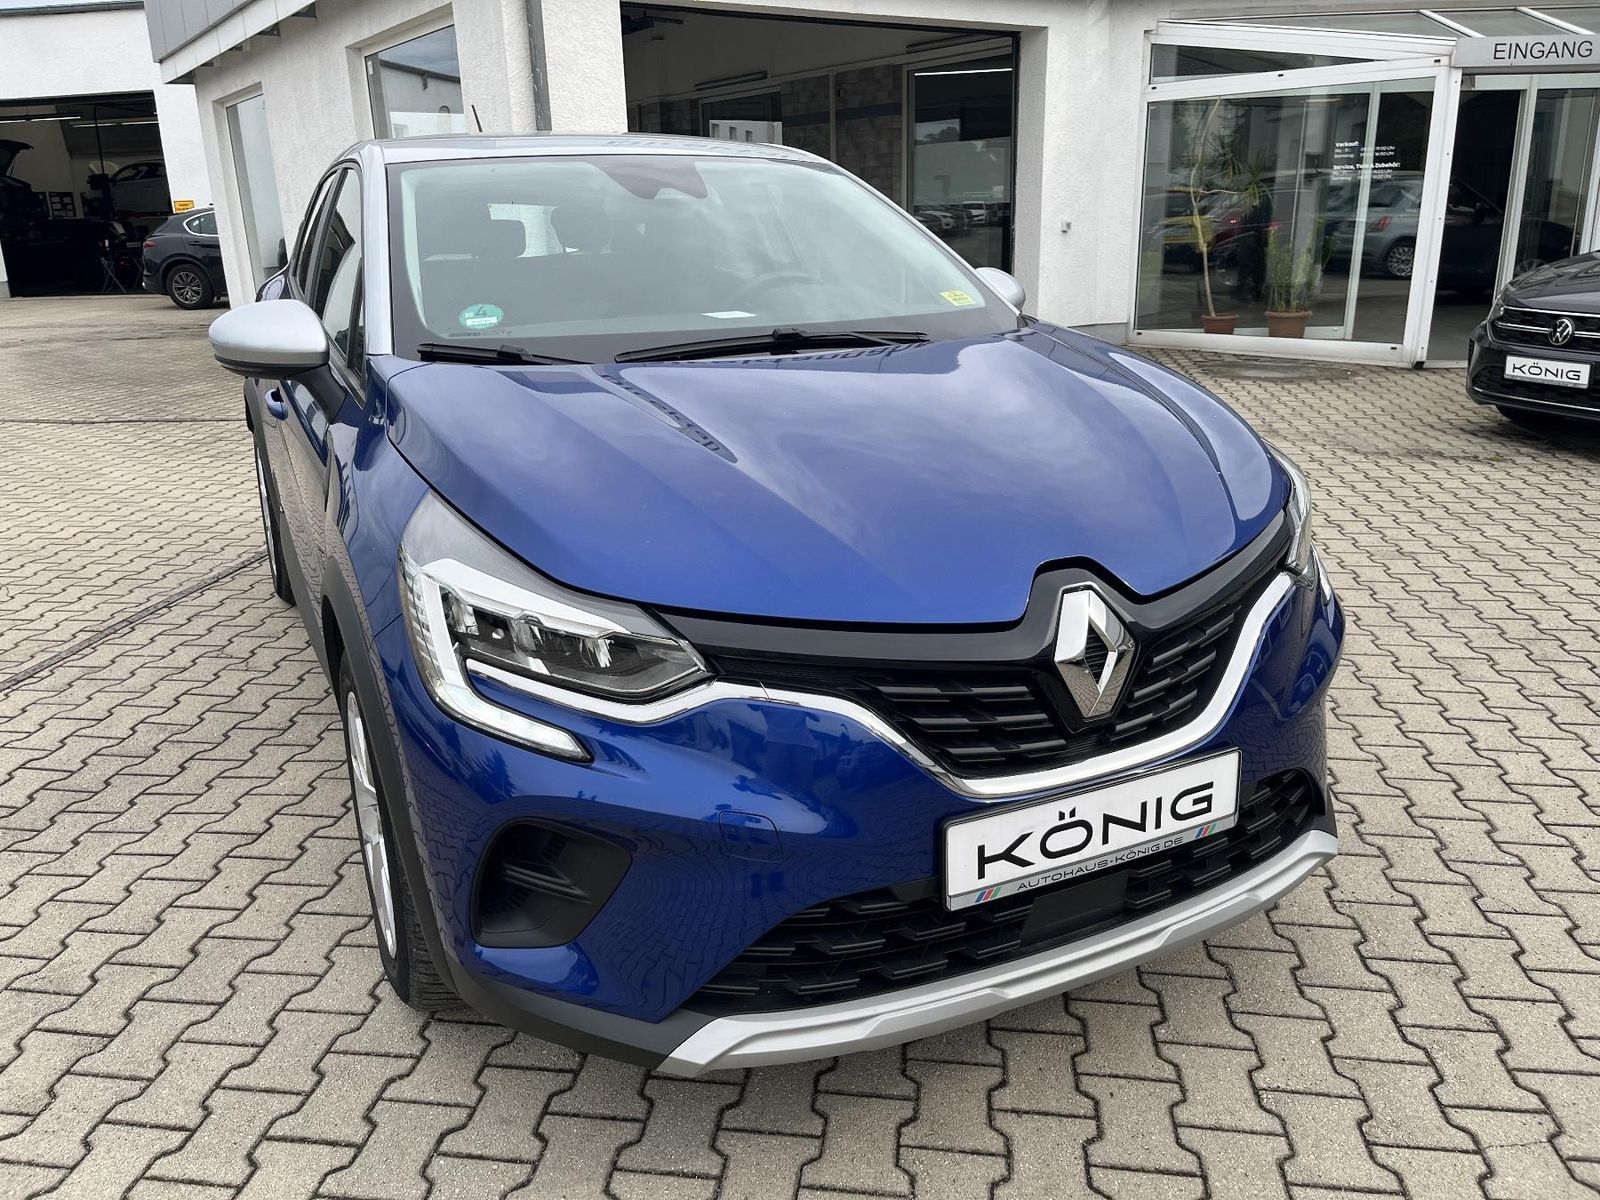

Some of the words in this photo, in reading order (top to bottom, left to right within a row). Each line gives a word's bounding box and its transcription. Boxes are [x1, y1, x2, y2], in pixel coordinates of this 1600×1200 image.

[1493, 41, 1593, 60] EINGANG
[1512, 362, 1581, 381] KÖNIG
[977, 781, 1214, 880] KÖNIG
